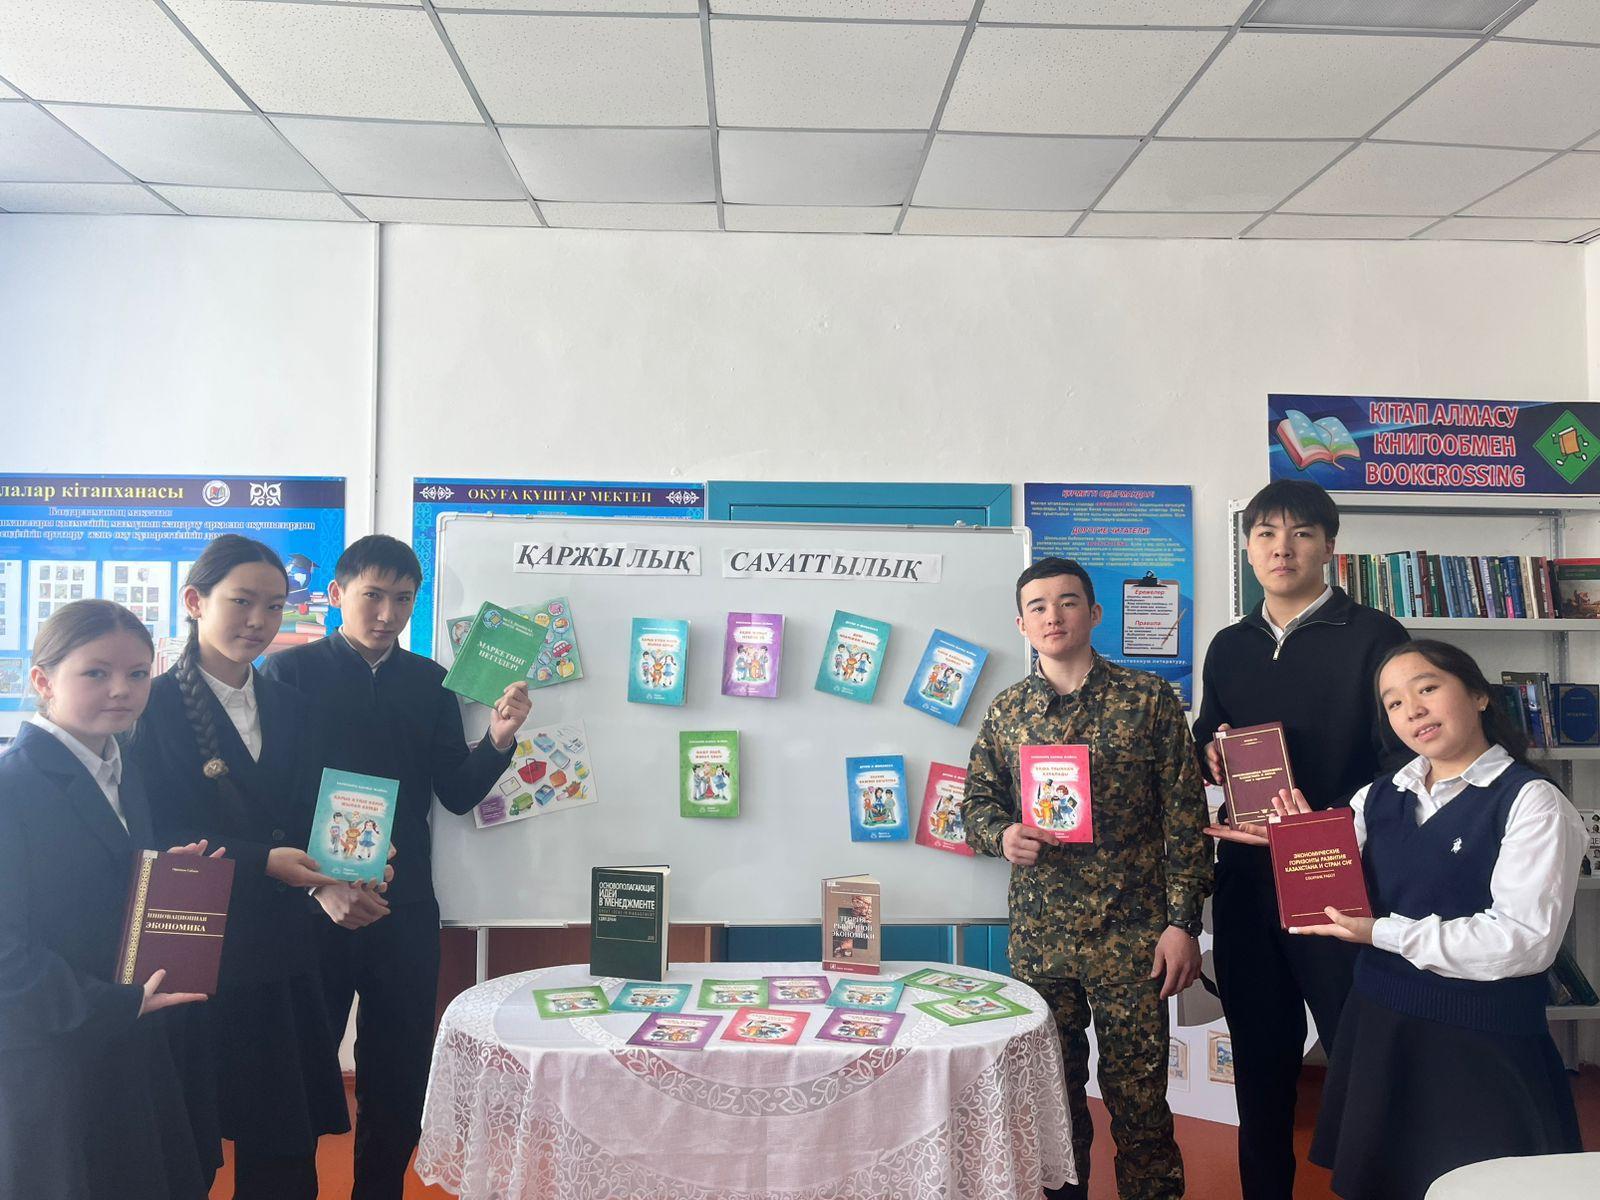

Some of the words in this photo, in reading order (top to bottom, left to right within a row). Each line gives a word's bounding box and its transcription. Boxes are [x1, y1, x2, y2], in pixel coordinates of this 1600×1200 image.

[1370, 402, 1428, 424] КІТАП
[1432, 403, 1519, 428] АЛМАСУ
[1374, 432, 1516, 457] КНИГООБМЕН
[1365, 463, 1525, 487] BOOKCROSSING
[62, 483, 184, 499] кітапханасы
[468, 488, 518, 501] ОҚУҒА
[591, 491, 652, 503] МЕКТЕП
[730, 551, 922, 581] САУАТТЫЛЫҚ
[479, 641, 527, 666] МАРКЕТИНГ
[1289, 857, 1320, 866] ГОРИЗОНТЫ
[1320, 853, 1347, 862] РАЗВИТИЯ
[1293, 848, 1340, 859] ЭКОНОМИЧЕСКИЕ
[1285, 864, 1318, 872] КАЗАХСТАНА
[599, 882, 655, 892] ОСНОВОПОЛАГАЮЩИЕ
[599, 889, 617, 898] ИДЕИ
[599, 898, 604, 906] В
[604, 899, 655, 910] МЕНЕДЖМЕНТЕ
[145, 921, 206, 932] ЭКОНОМИКА
[832, 931, 875, 940] ЭКОНОМИКИ
